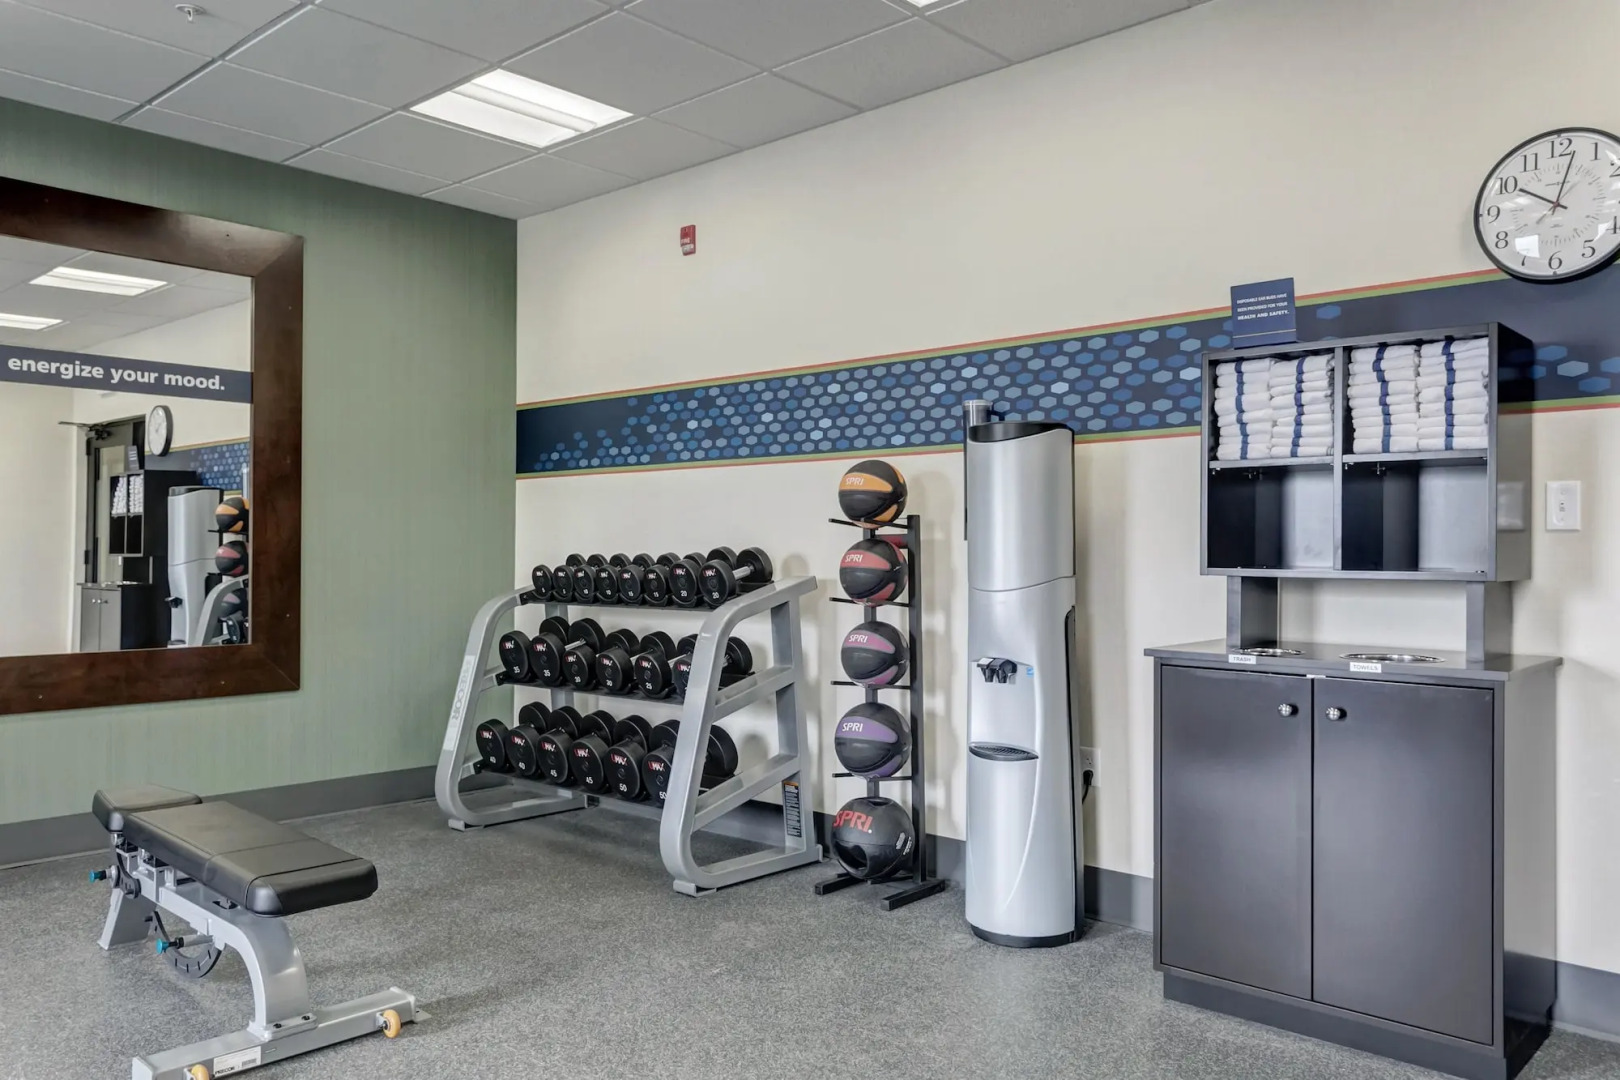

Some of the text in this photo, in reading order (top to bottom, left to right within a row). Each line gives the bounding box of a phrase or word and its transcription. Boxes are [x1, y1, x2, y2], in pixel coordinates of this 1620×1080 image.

[1546, 137, 1573, 160] 12
[1589, 142, 1602, 162] 1
[1519, 152, 1541, 174] 11
[1496, 175, 1519, 196] 10
[1486, 204, 1501, 224] 9
[1494, 230, 1509, 249] 8
[1581, 238, 1596, 259] 5
[1548, 250, 1563, 270] 6
[8, 357, 226, 391] energize your mood.
[845, 477, 864, 486] SPRI
[844, 554, 864, 563] SPRI
[848, 634, 868, 644] SPRI
[513, 666, 521, 674] 35
[543, 669, 551, 677] 35
[645, 682, 653, 690] 25
[842, 722, 864, 732] SPRI
[489, 756, 497, 764] 40
[518, 761, 526, 770] 40
[550, 769, 558, 778] 45
[585, 776, 594, 785] 45
[619, 783, 628, 792] 50
